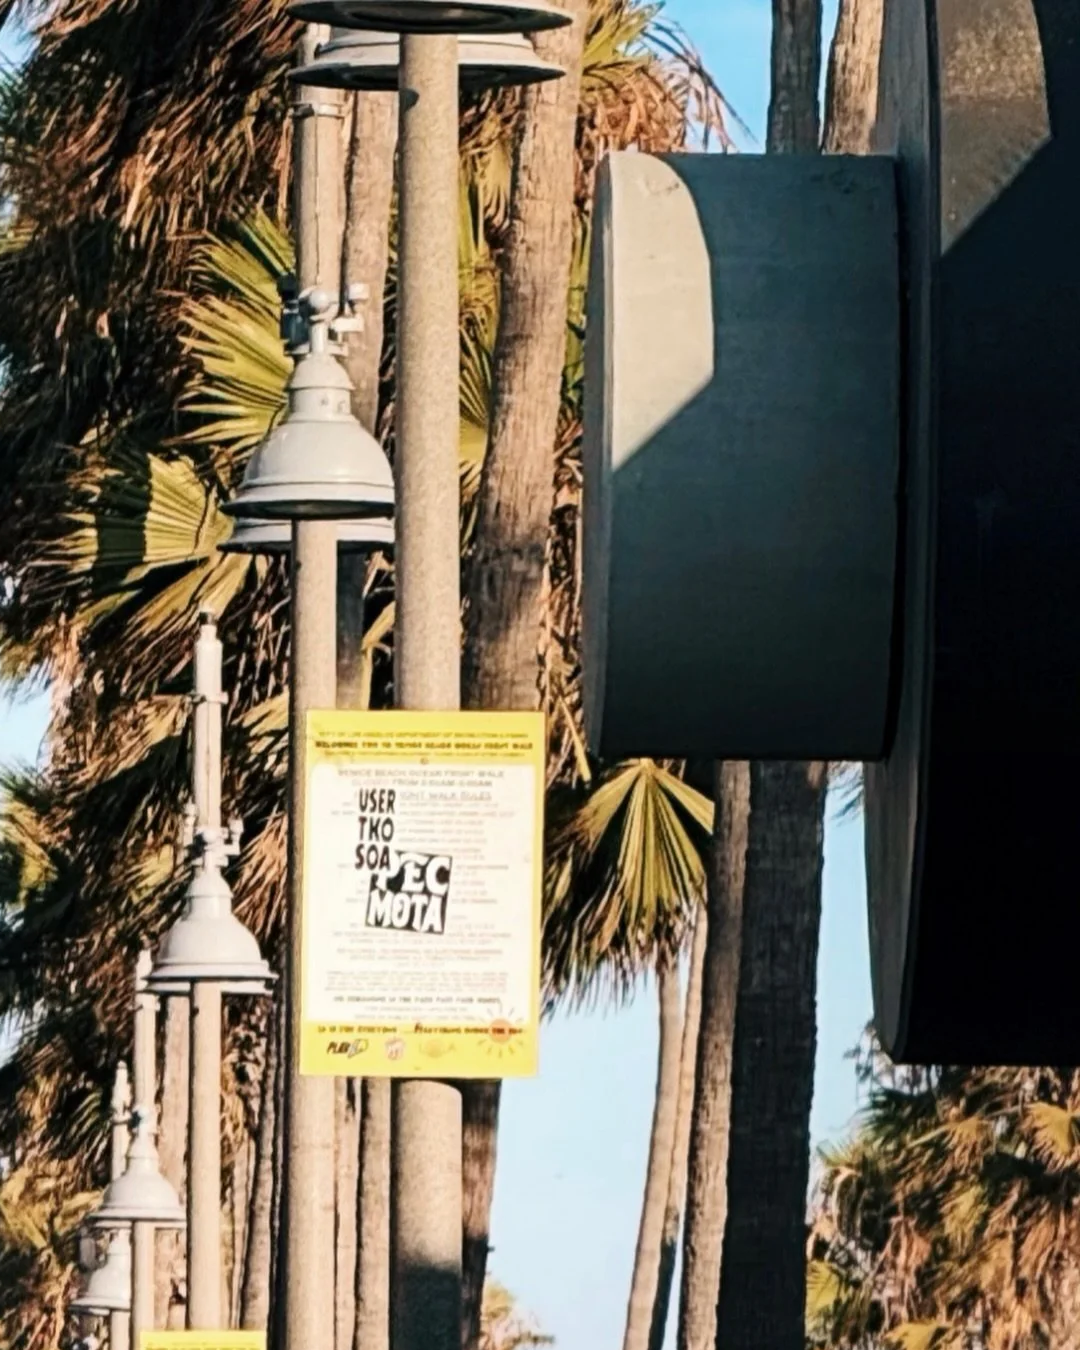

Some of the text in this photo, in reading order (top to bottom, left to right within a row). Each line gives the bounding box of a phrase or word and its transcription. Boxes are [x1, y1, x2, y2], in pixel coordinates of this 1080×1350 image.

[359, 788, 396, 814] USER
[358, 816, 395, 842] TKO
[355, 843, 390, 871] SOA
[366, 888, 444, 933] MOTA
